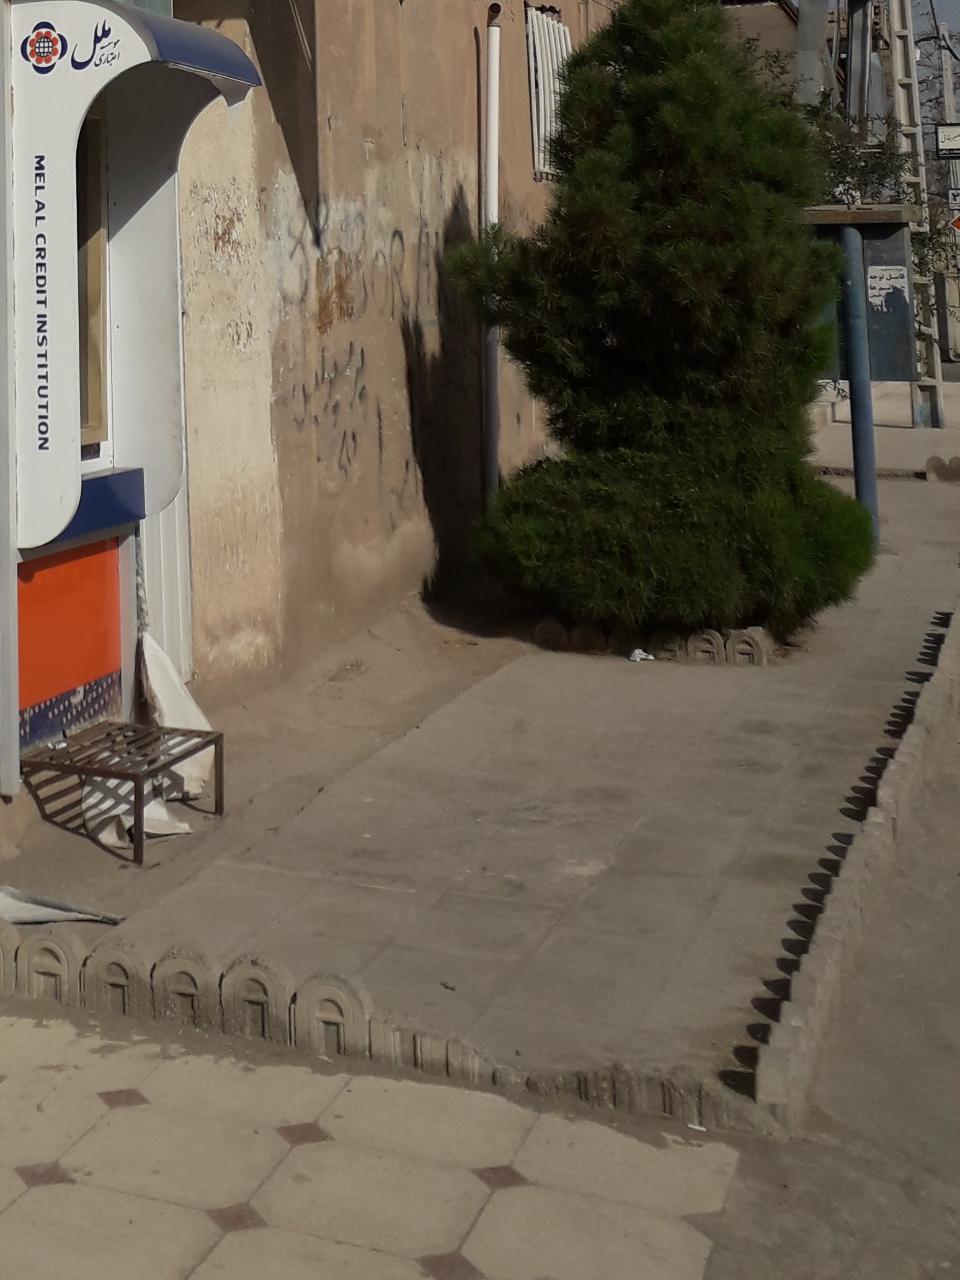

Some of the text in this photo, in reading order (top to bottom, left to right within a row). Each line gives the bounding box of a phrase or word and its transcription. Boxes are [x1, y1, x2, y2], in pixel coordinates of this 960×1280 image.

[71, 19, 112, 70] ملل
[34, 155, 49, 451] MELAL CREDIT INSTITUTION
